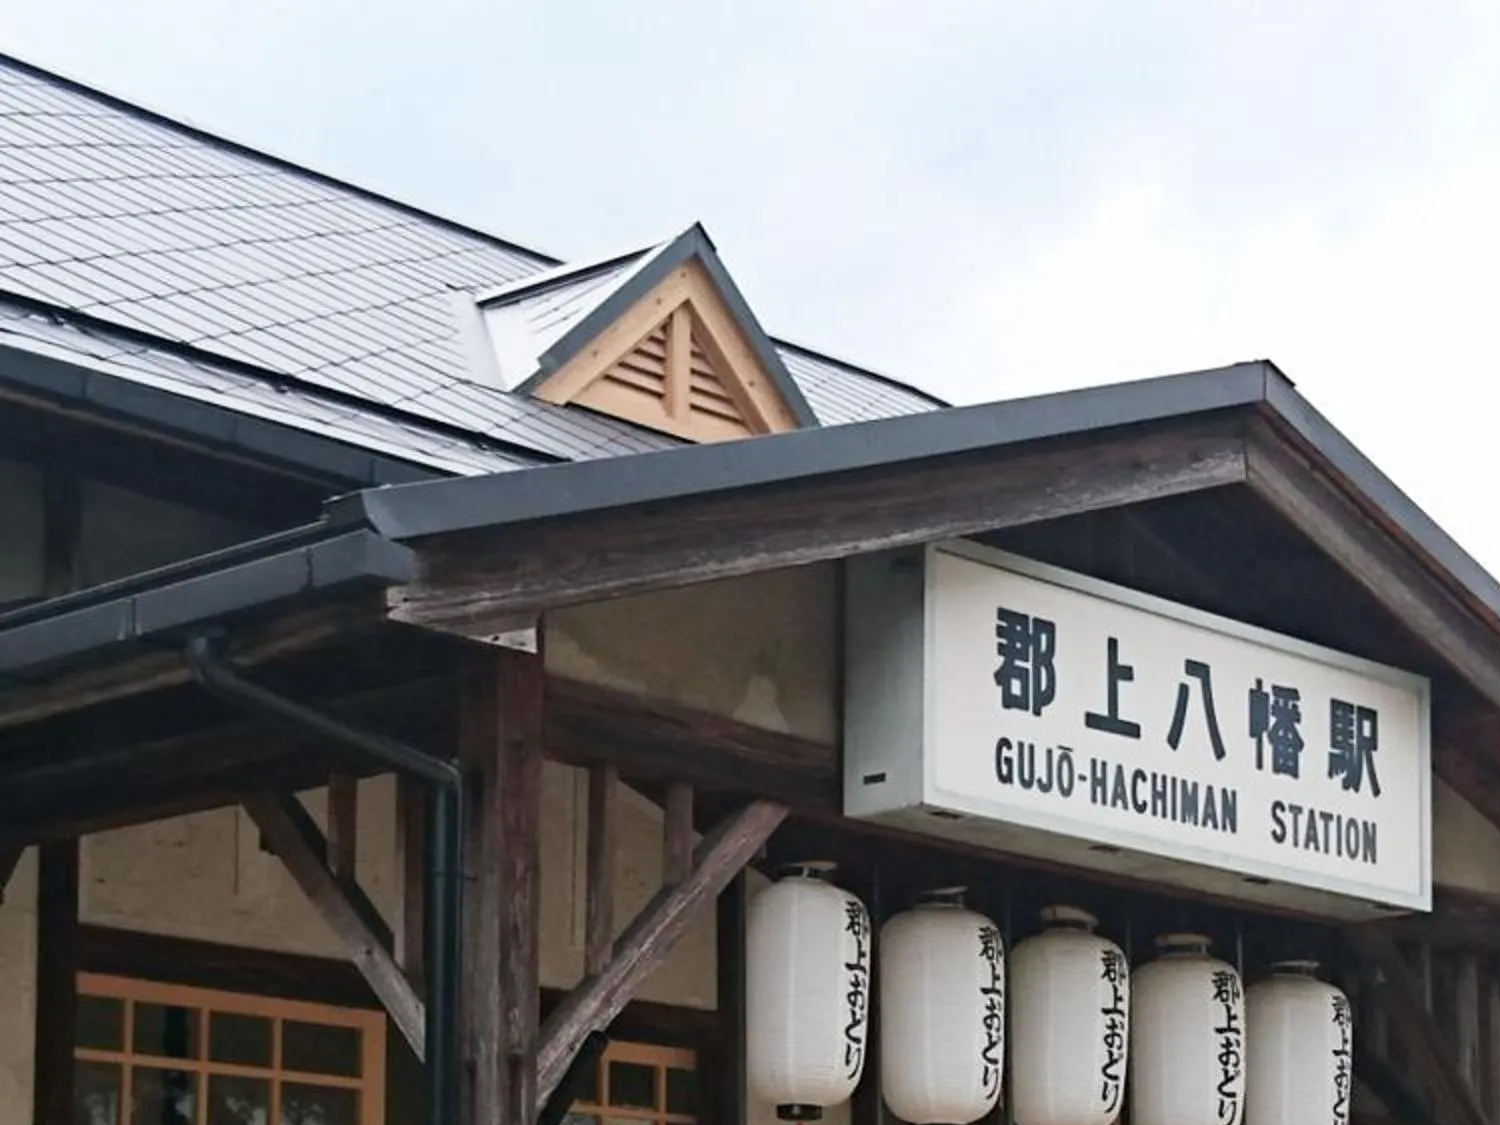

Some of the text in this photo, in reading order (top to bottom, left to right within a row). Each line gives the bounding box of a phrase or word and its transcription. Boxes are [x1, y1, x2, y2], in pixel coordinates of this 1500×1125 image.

[993, 607, 1381, 798] 郡上八幡駅
[1271, 800, 1377, 865] STATION
